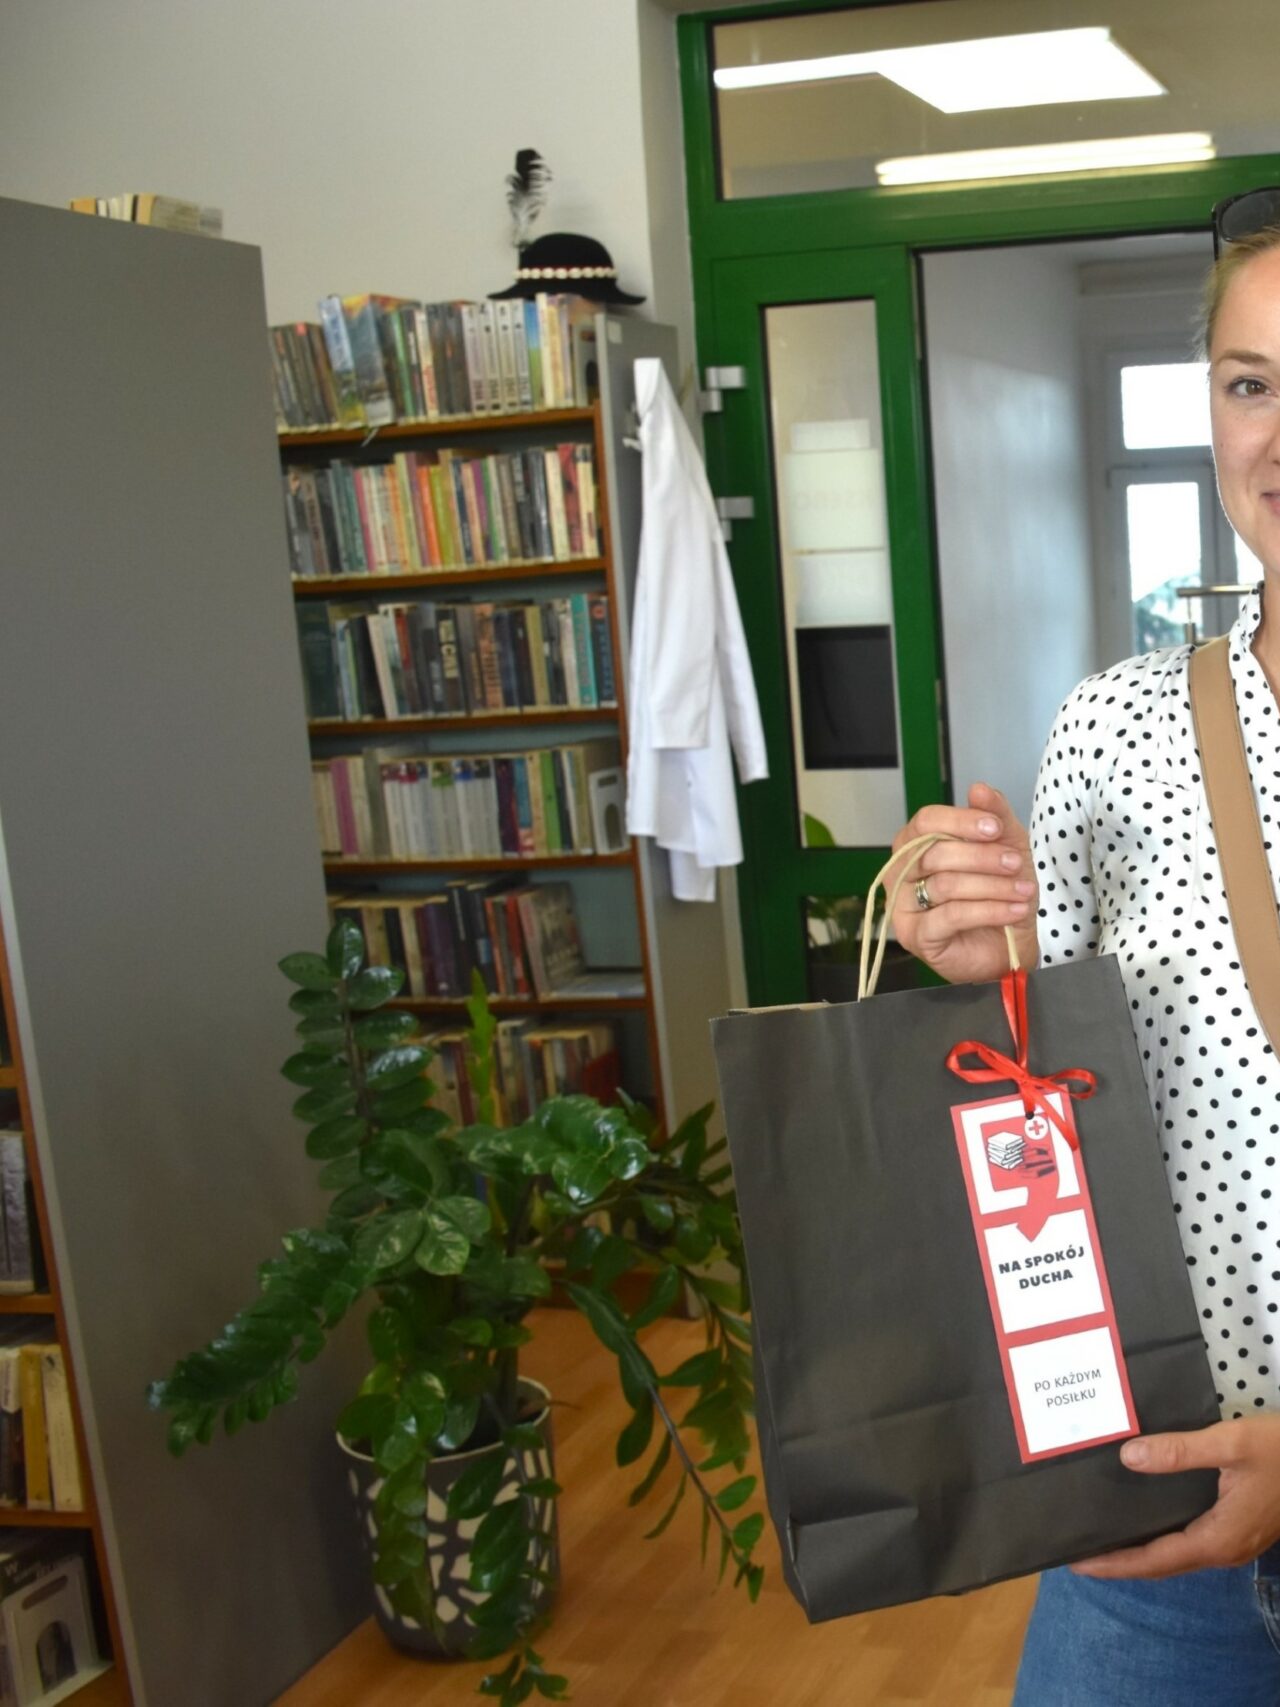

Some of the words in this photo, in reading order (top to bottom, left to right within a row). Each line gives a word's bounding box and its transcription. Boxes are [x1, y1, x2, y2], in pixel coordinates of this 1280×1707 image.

[998, 1260, 1022, 1275] NA
[1024, 1244, 1086, 1268] SPOKÓJ
[1018, 1269, 1074, 1290] DUCHA
[1034, 1380, 1051, 1393] PO
[1054, 1368, 1102, 1388] KAŻDYM
[1046, 1388, 1097, 1408] POSIŁKU
